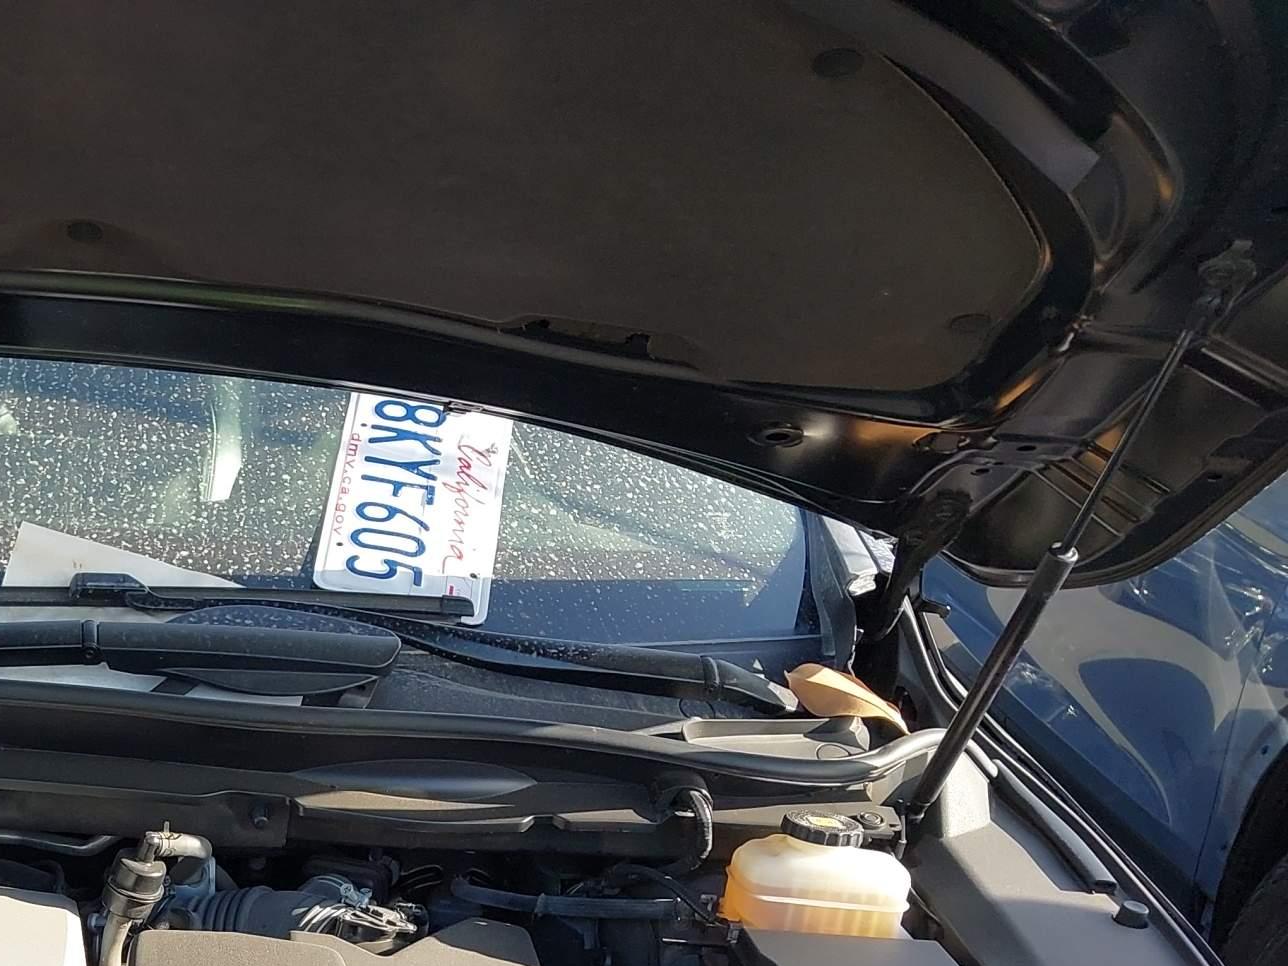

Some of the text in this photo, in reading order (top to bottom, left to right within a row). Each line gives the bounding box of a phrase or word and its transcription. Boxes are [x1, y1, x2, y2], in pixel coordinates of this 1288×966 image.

[333, 432, 362, 536] dmv.ca.gov
[346, 399, 447, 587] 8KYF605
[443, 435, 492, 574] California
